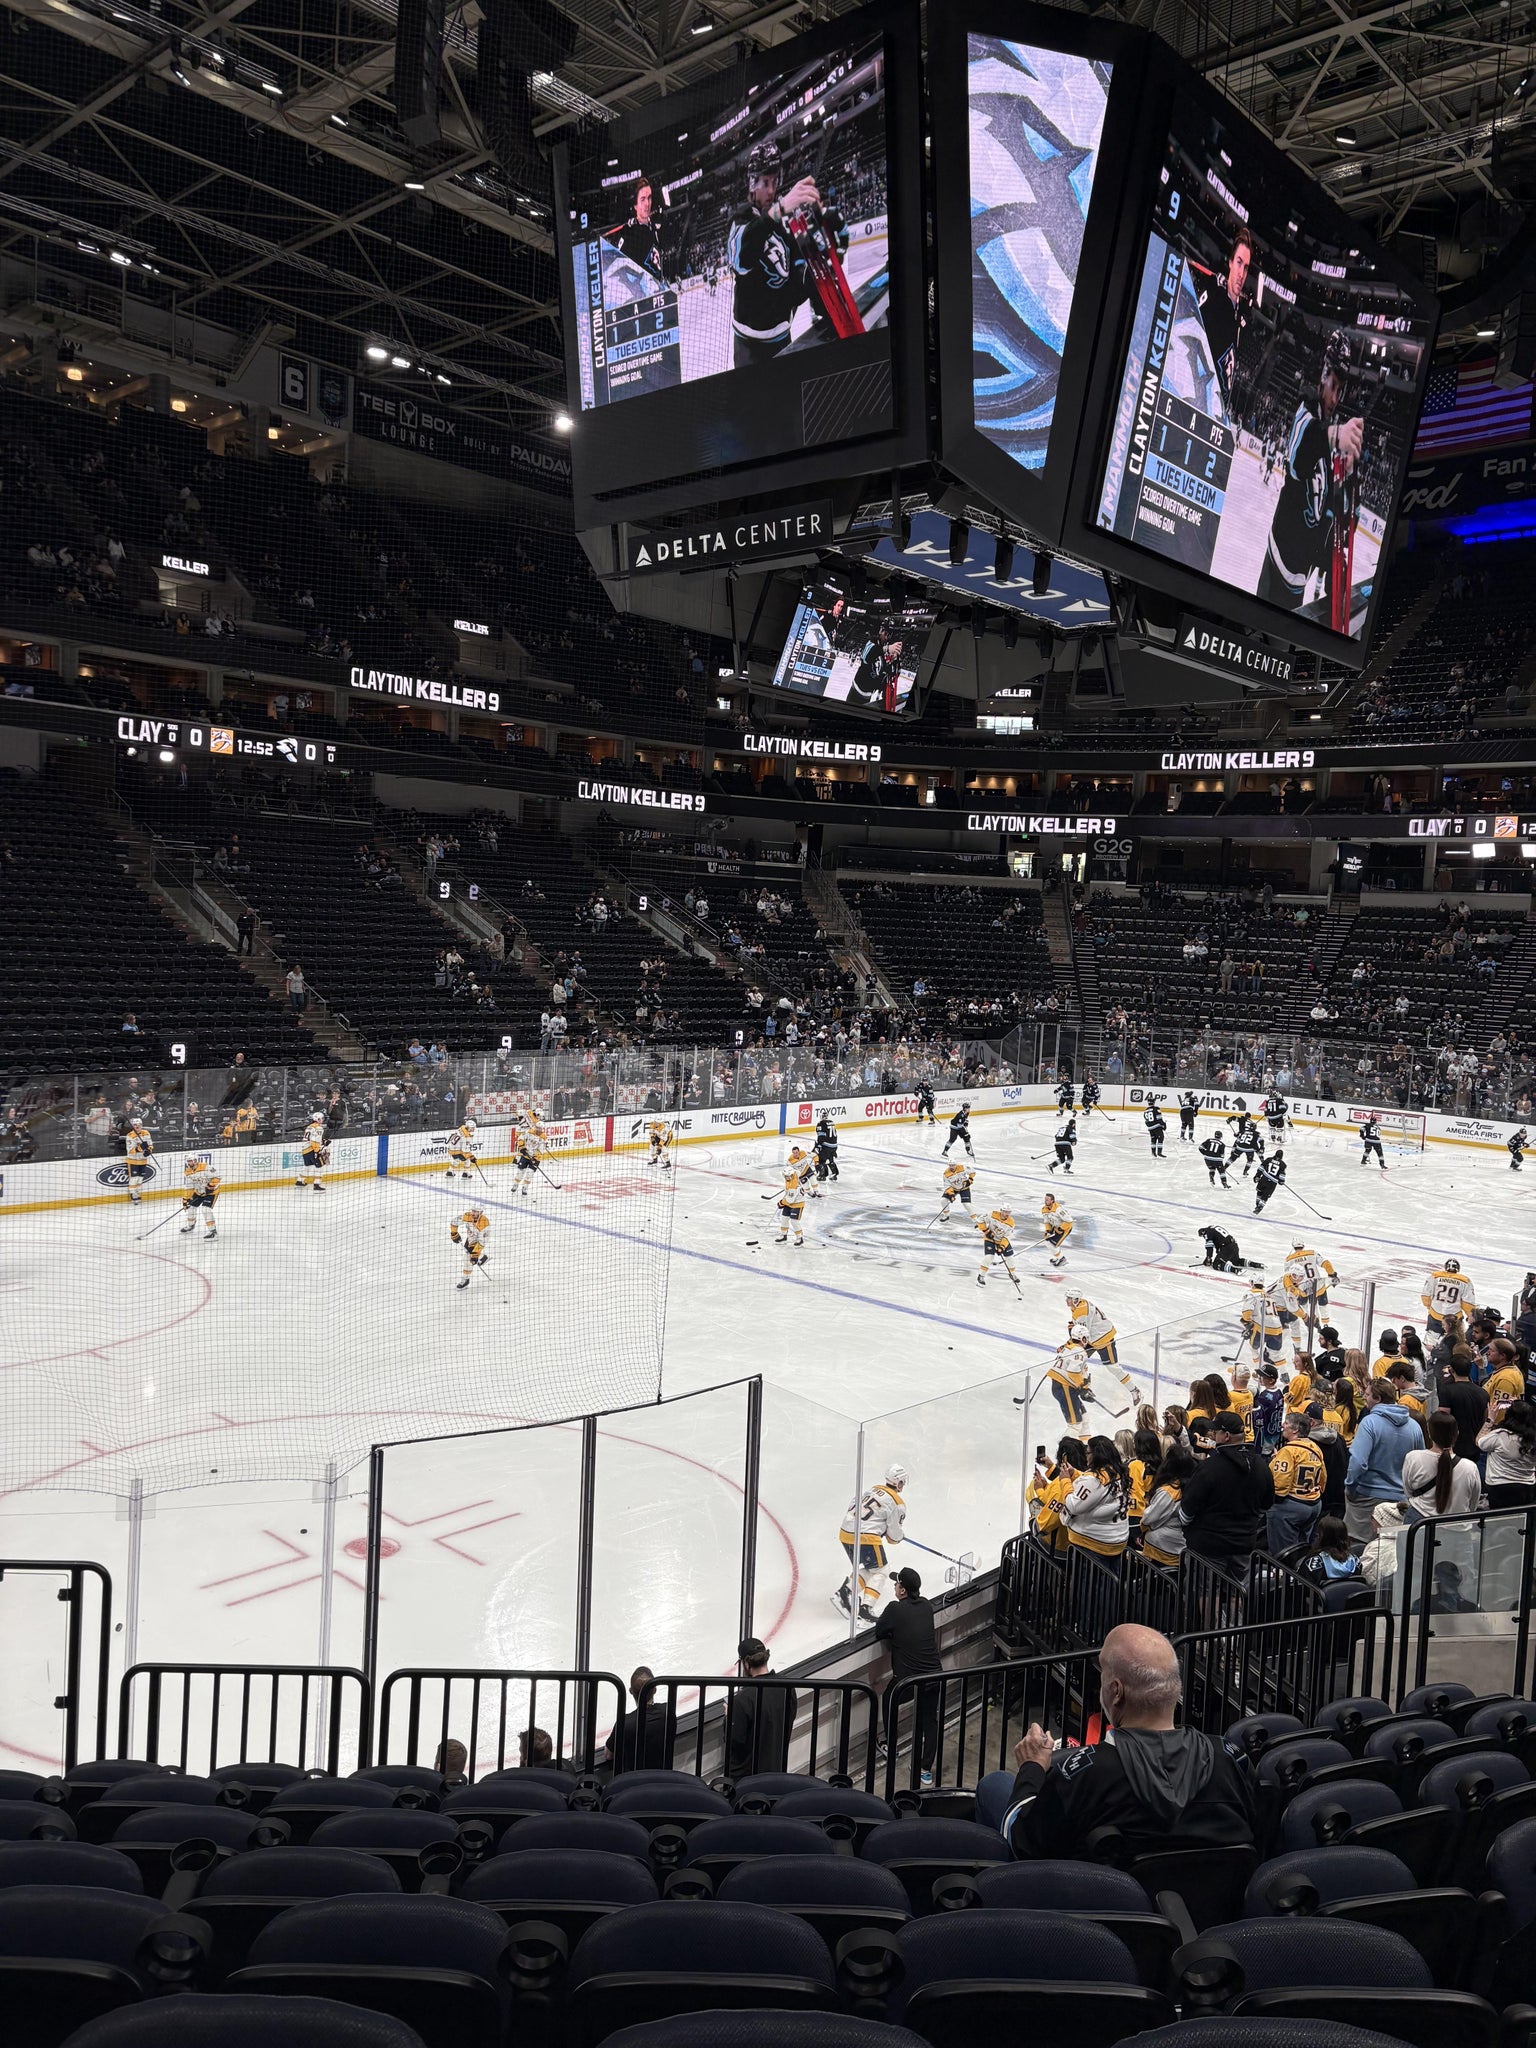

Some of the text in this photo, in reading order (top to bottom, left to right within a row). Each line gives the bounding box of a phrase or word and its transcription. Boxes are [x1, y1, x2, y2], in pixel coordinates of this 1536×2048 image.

[1168, 190, 1180, 220] 9
[580, 212, 588, 229] 9
[589, 241, 605, 368] CLAYTON KELLER
[611, 294, 665, 322] G A PTS
[612, 312, 664, 343] 1 1 2
[615, 331, 671, 360] TUES VS EDM
[609, 351, 663, 375] SCORED OVERTIME GAME
[1129, 252, 1181, 475] CLAYTON KELLER
[285, 366, 304, 400] 6
[631, 370, 643, 382] GOAL
[359, 392, 456, 437] TEE BOX
[1165, 398, 1224, 447] G A PTS
[381, 421, 435, 451] LOUNGE
[1104, 352, 1142, 512] MAMMOTH
[1159, 424, 1217, 479] 1 1 2
[1483, 457, 1526, 478] Fan
[1156, 460, 1217, 509] TUES VS EDM
[1403, 472, 1463, 513] rd
[1142, 485, 1203, 527] SCORED OVERTIME GAME
[1138, 505, 1162, 529] WINNING
[1162, 515, 1175, 535] GOAL
[657, 513, 822, 561] DELTA CENTER
[162, 554, 210, 575] KELLER
[1199, 632, 1291, 680] DELTA CENTER
[351, 666, 500, 712] CLAYTON KELLER 9
[118, 717, 165, 743] CLAY
[168, 731, 177, 742] 0
[189, 728, 202, 746] 0
[237, 739, 274, 757] 12:52
[305, 744, 316, 761] 0
[327, 753, 335, 762] 0
[743, 734, 882, 763] CLAYTON KELLER 9
[1161, 750, 1315, 770] CLAYTON KELLER 9
[578, 781, 706, 812] CLAYTON KELLER 9
[967, 814, 1116, 835] CLAYTON KELLER 9
[1454, 824, 1462, 834] 0
[1474, 819, 1487, 834] 0
[1094, 838, 1133, 854] G2G
[718, 864, 740, 873] HEALTH
[440, 882, 450, 898] 9
[639, 896, 648, 910] 9
[172, 1044, 185, 1064] 9
[1002, 1087, 1022, 1100] VLCM
[815, 1106, 847, 1118] TOYOTA
[865, 1097, 919, 1118] entrata
[1293, 1103, 1337, 1119] ELTA
[1353, 1111, 1383, 1122] SME
[711, 1110, 766, 1129] NITECRAWLER
[1386, 1116, 1415, 1125] STEEL
[1240, 1134, 1253, 1145] 92
[1445, 1127, 1503, 1140] AMERICA FIRST
[339, 1148, 359, 1159] G2G
[420, 1146, 449, 1157] AMERI
[1209, 1142, 1220, 1153] 11
[251, 1155, 272, 1167] G2G
[1267, 1162, 1280, 1176] 13
[1304, 1263, 1314, 1278] 6
[1436, 1284, 1459, 1304] 29
[1528, 1351, 1536, 1363] 9
[1075, 1485, 1091, 1501] 16
